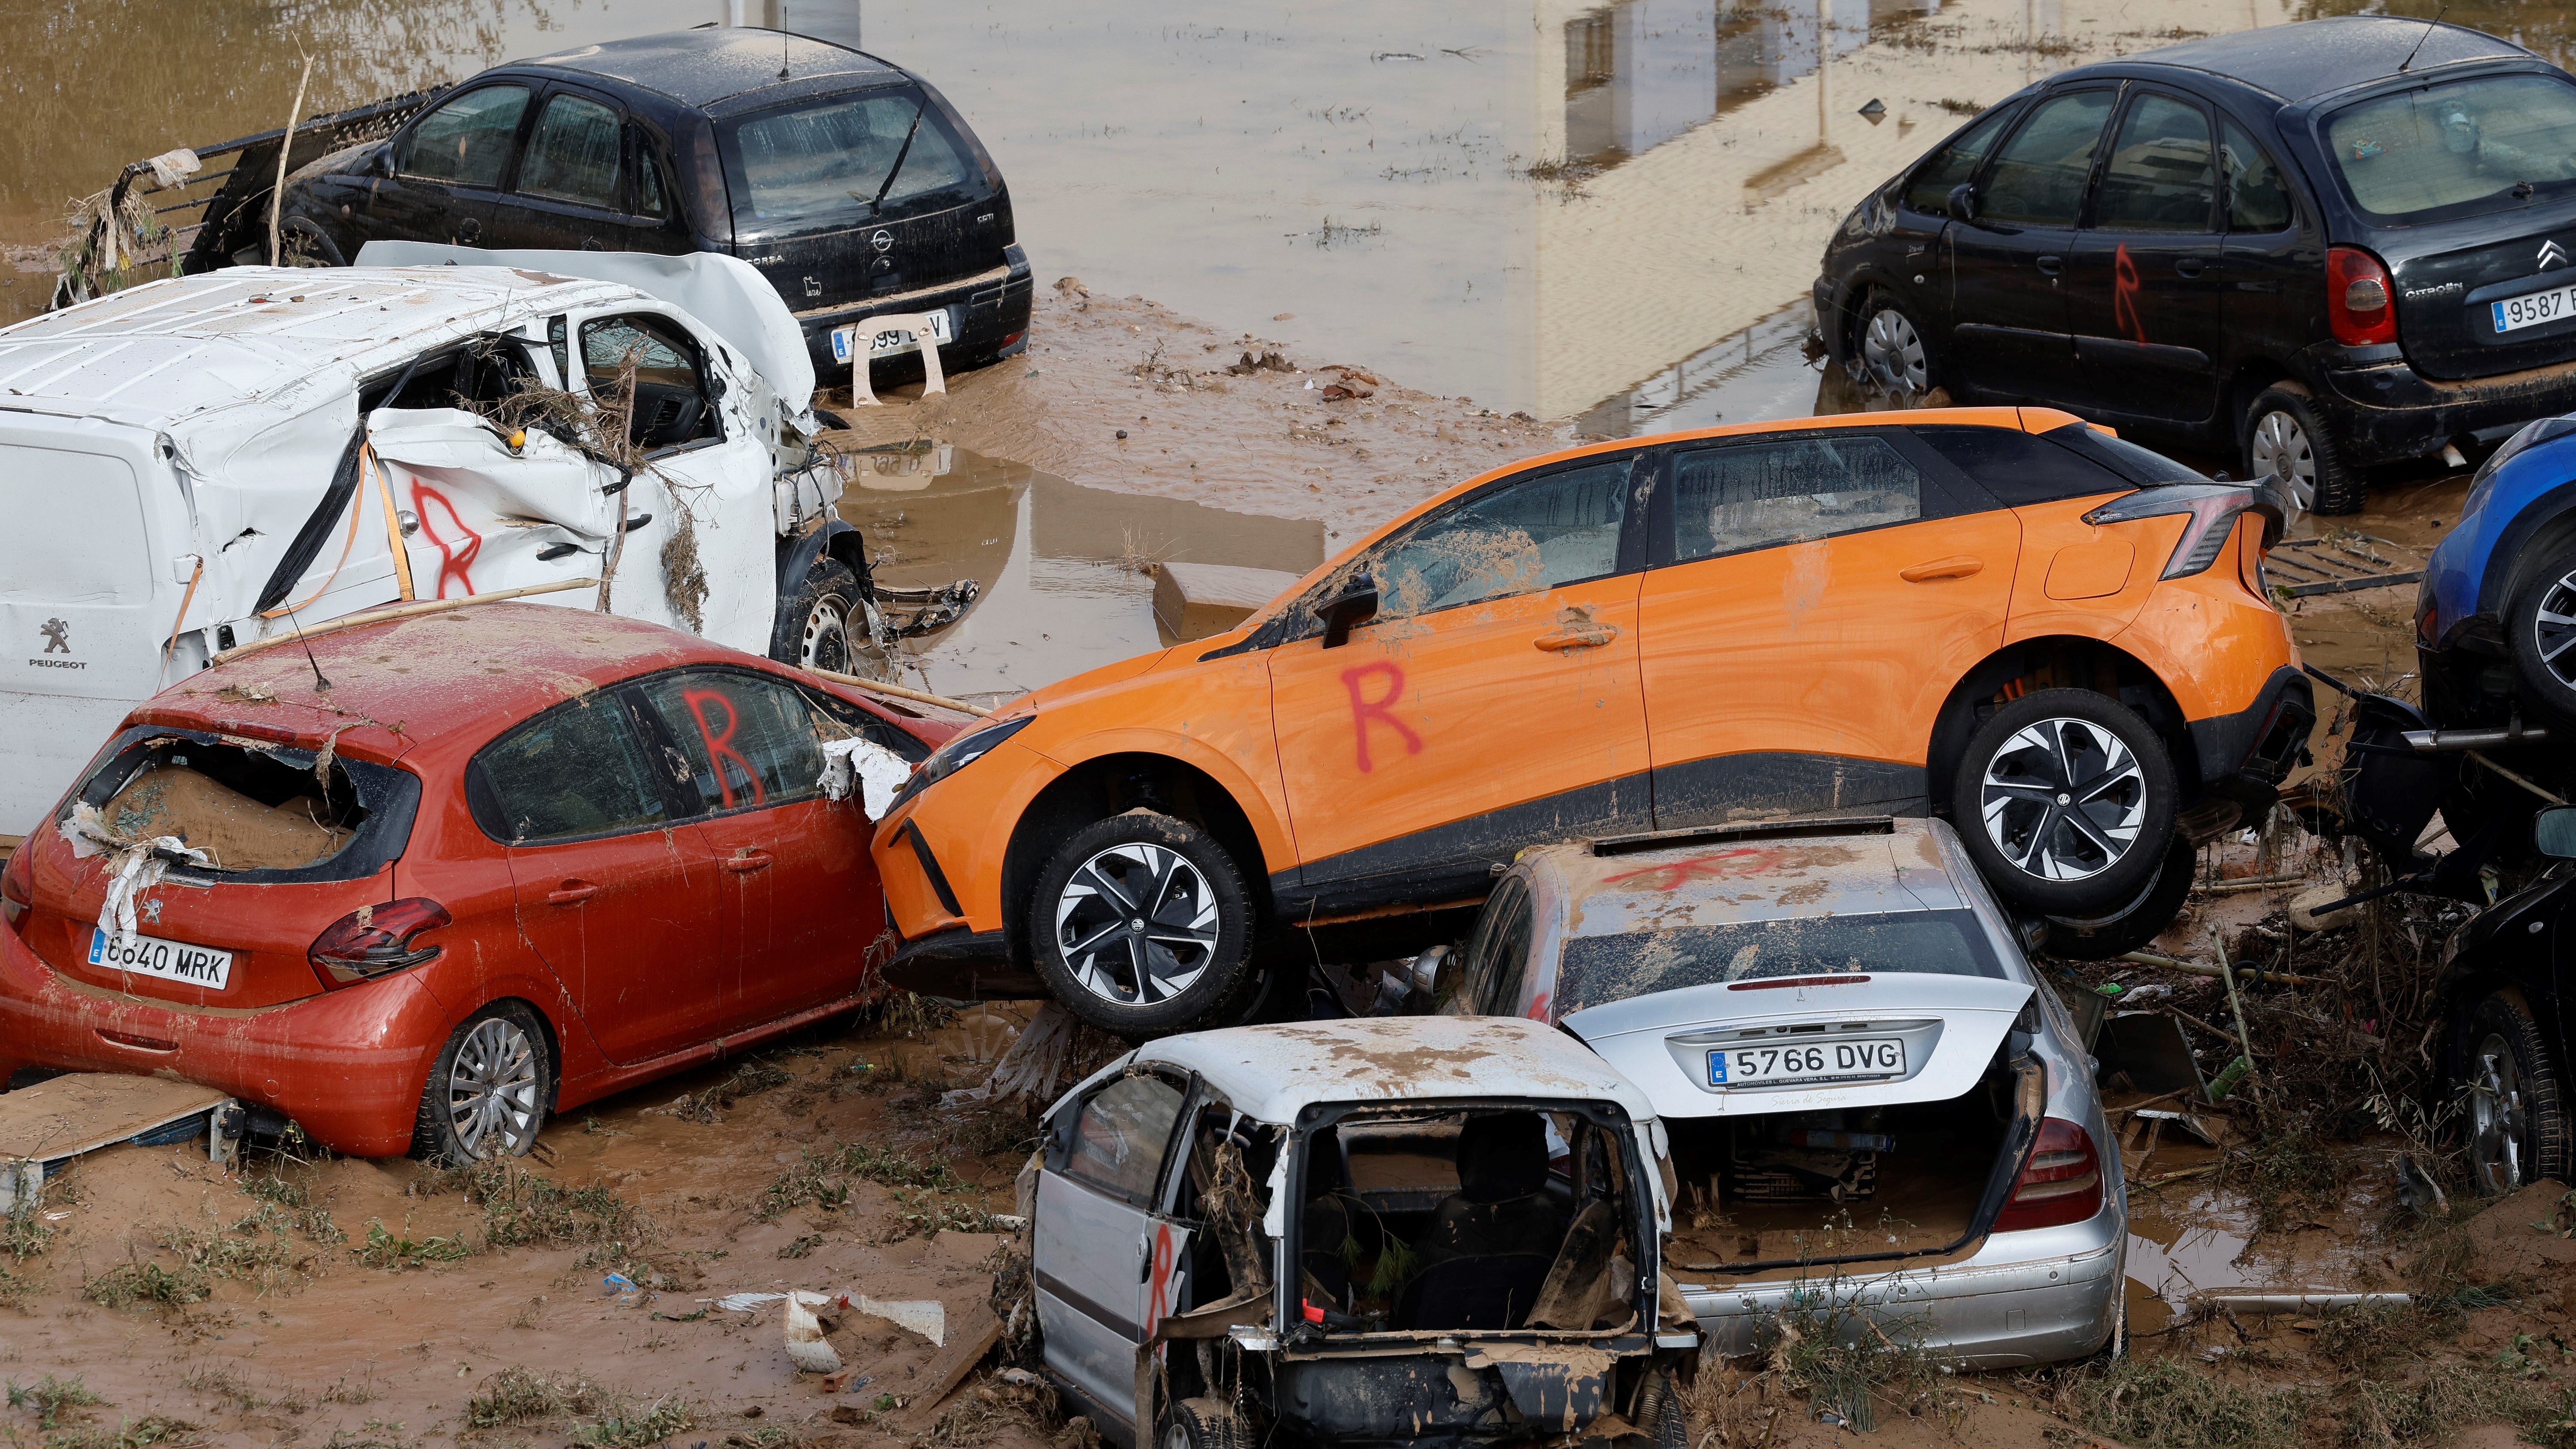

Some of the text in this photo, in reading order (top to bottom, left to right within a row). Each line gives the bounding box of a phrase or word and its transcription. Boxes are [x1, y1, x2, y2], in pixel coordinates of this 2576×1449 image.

[977, 213, 994, 222] CDTI
[2114, 240, 2147, 346] R
[2406, 283, 2463, 298] CITROËN
[2510, 292, 2561, 323] 9587
[411, 475, 482, 599] R
[29, 659, 87, 669] PEUGEOT
[1341, 660, 1424, 774] R
[684, 687, 765, 809] R
[175, 949, 225, 983] MRK
[1737, 1048, 1825, 1076] 5766
[1836, 1044, 1896, 1069] DVG
[1771, 1095, 1800, 1106] Sierra
[1816, 1092, 1846, 1106] Segura
[1147, 1224, 1172, 1355] R
